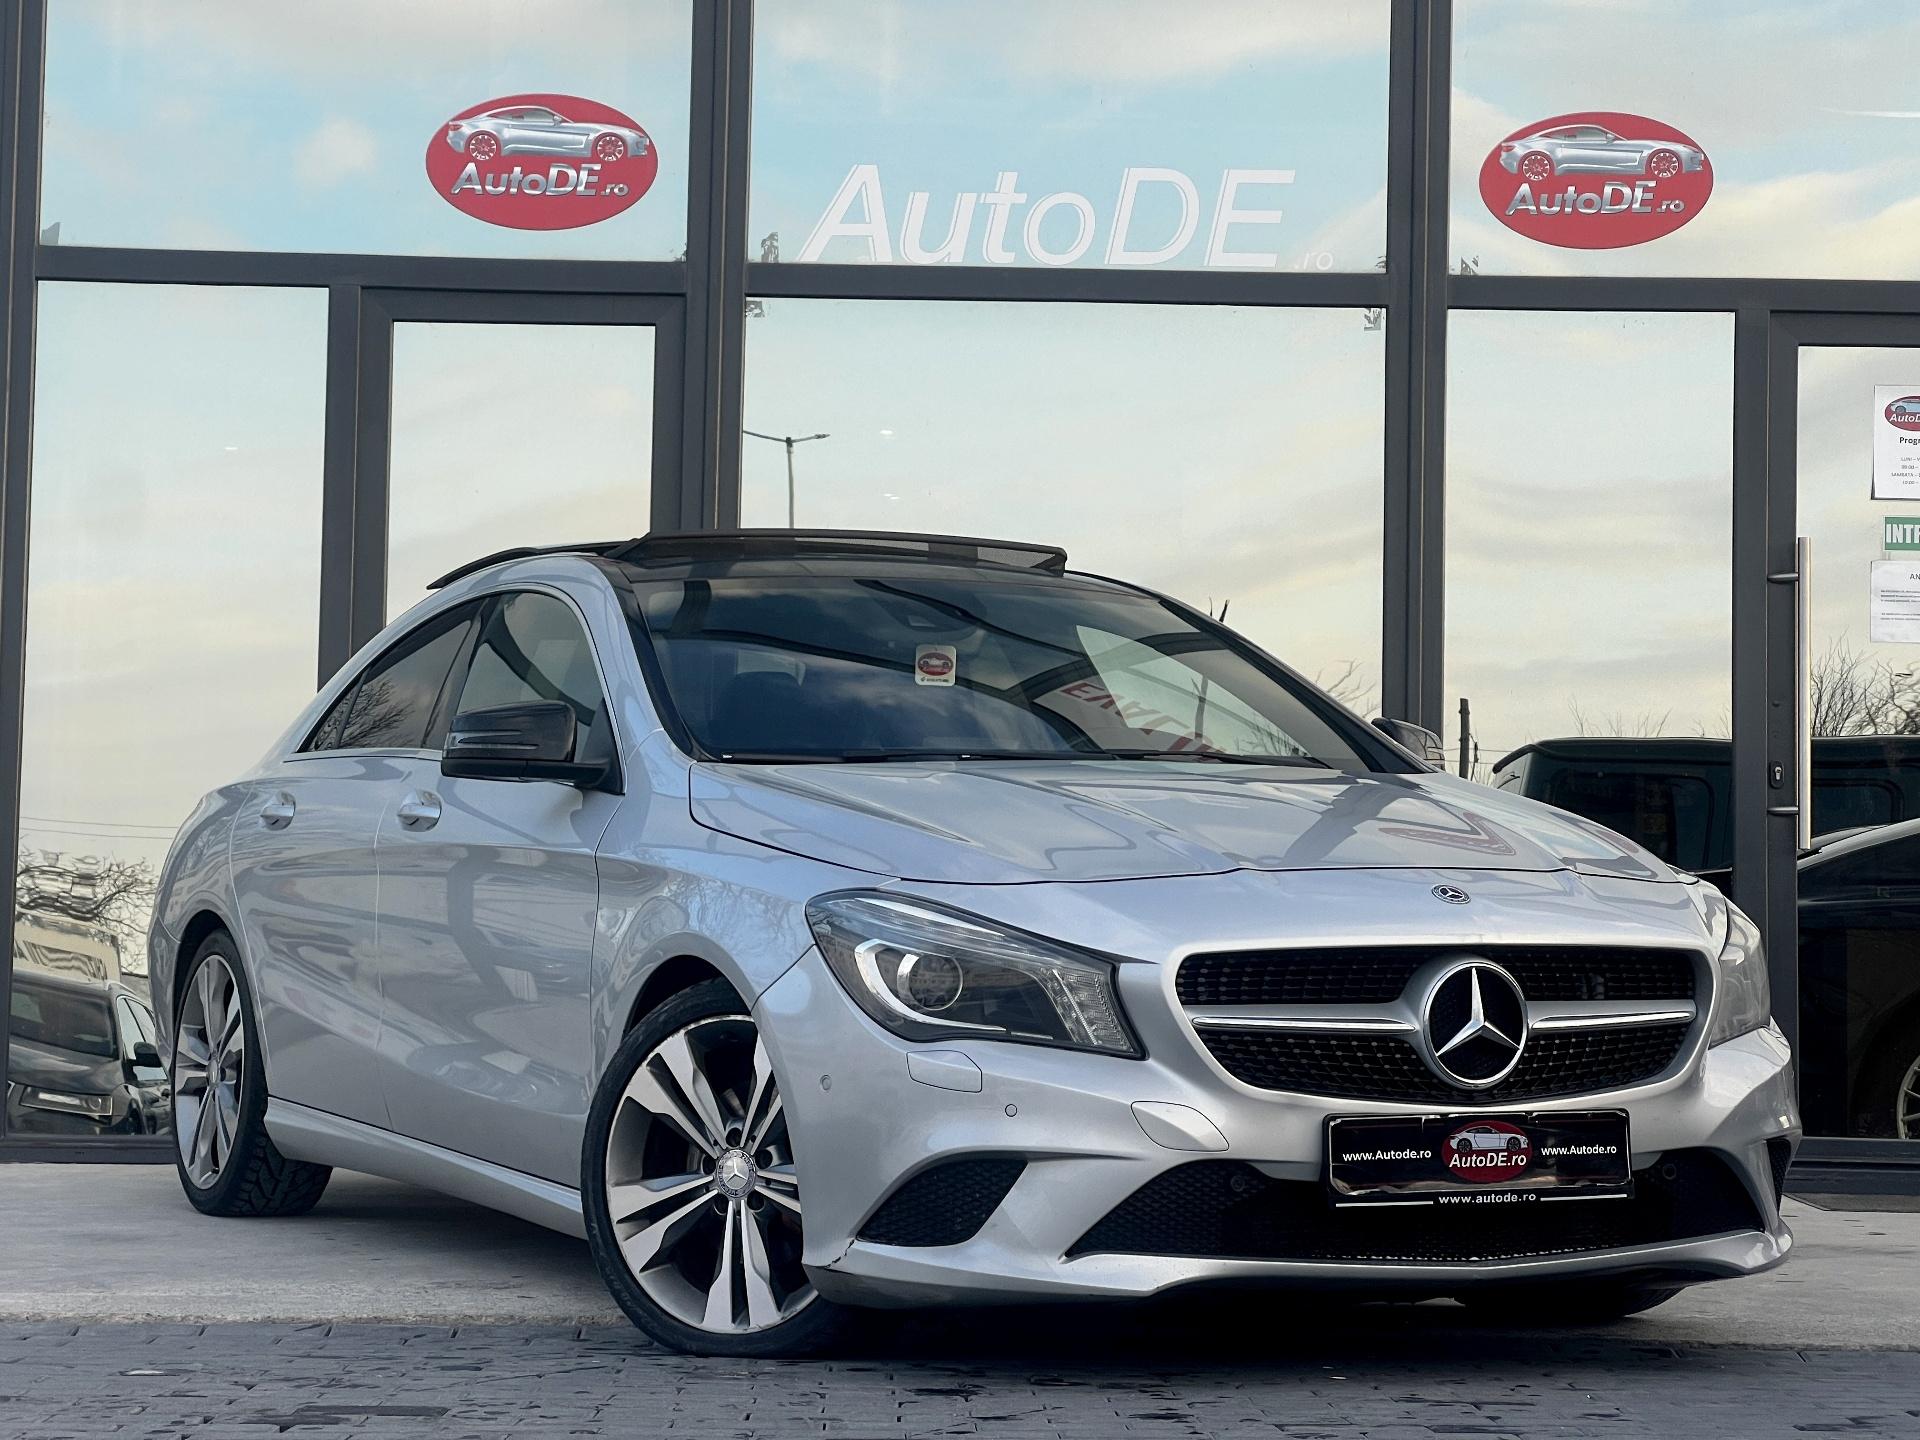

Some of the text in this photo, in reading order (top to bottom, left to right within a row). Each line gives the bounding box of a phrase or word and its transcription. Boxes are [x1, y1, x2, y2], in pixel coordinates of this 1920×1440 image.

[1342, 1148, 1432, 1162] www.Autode.ro
[1542, 1144, 1617, 1156] www.Autode.ro
[1449, 1152, 1527, 1168] AutoDE.ro
[1438, 1192, 1537, 1204] www.autode.ro
